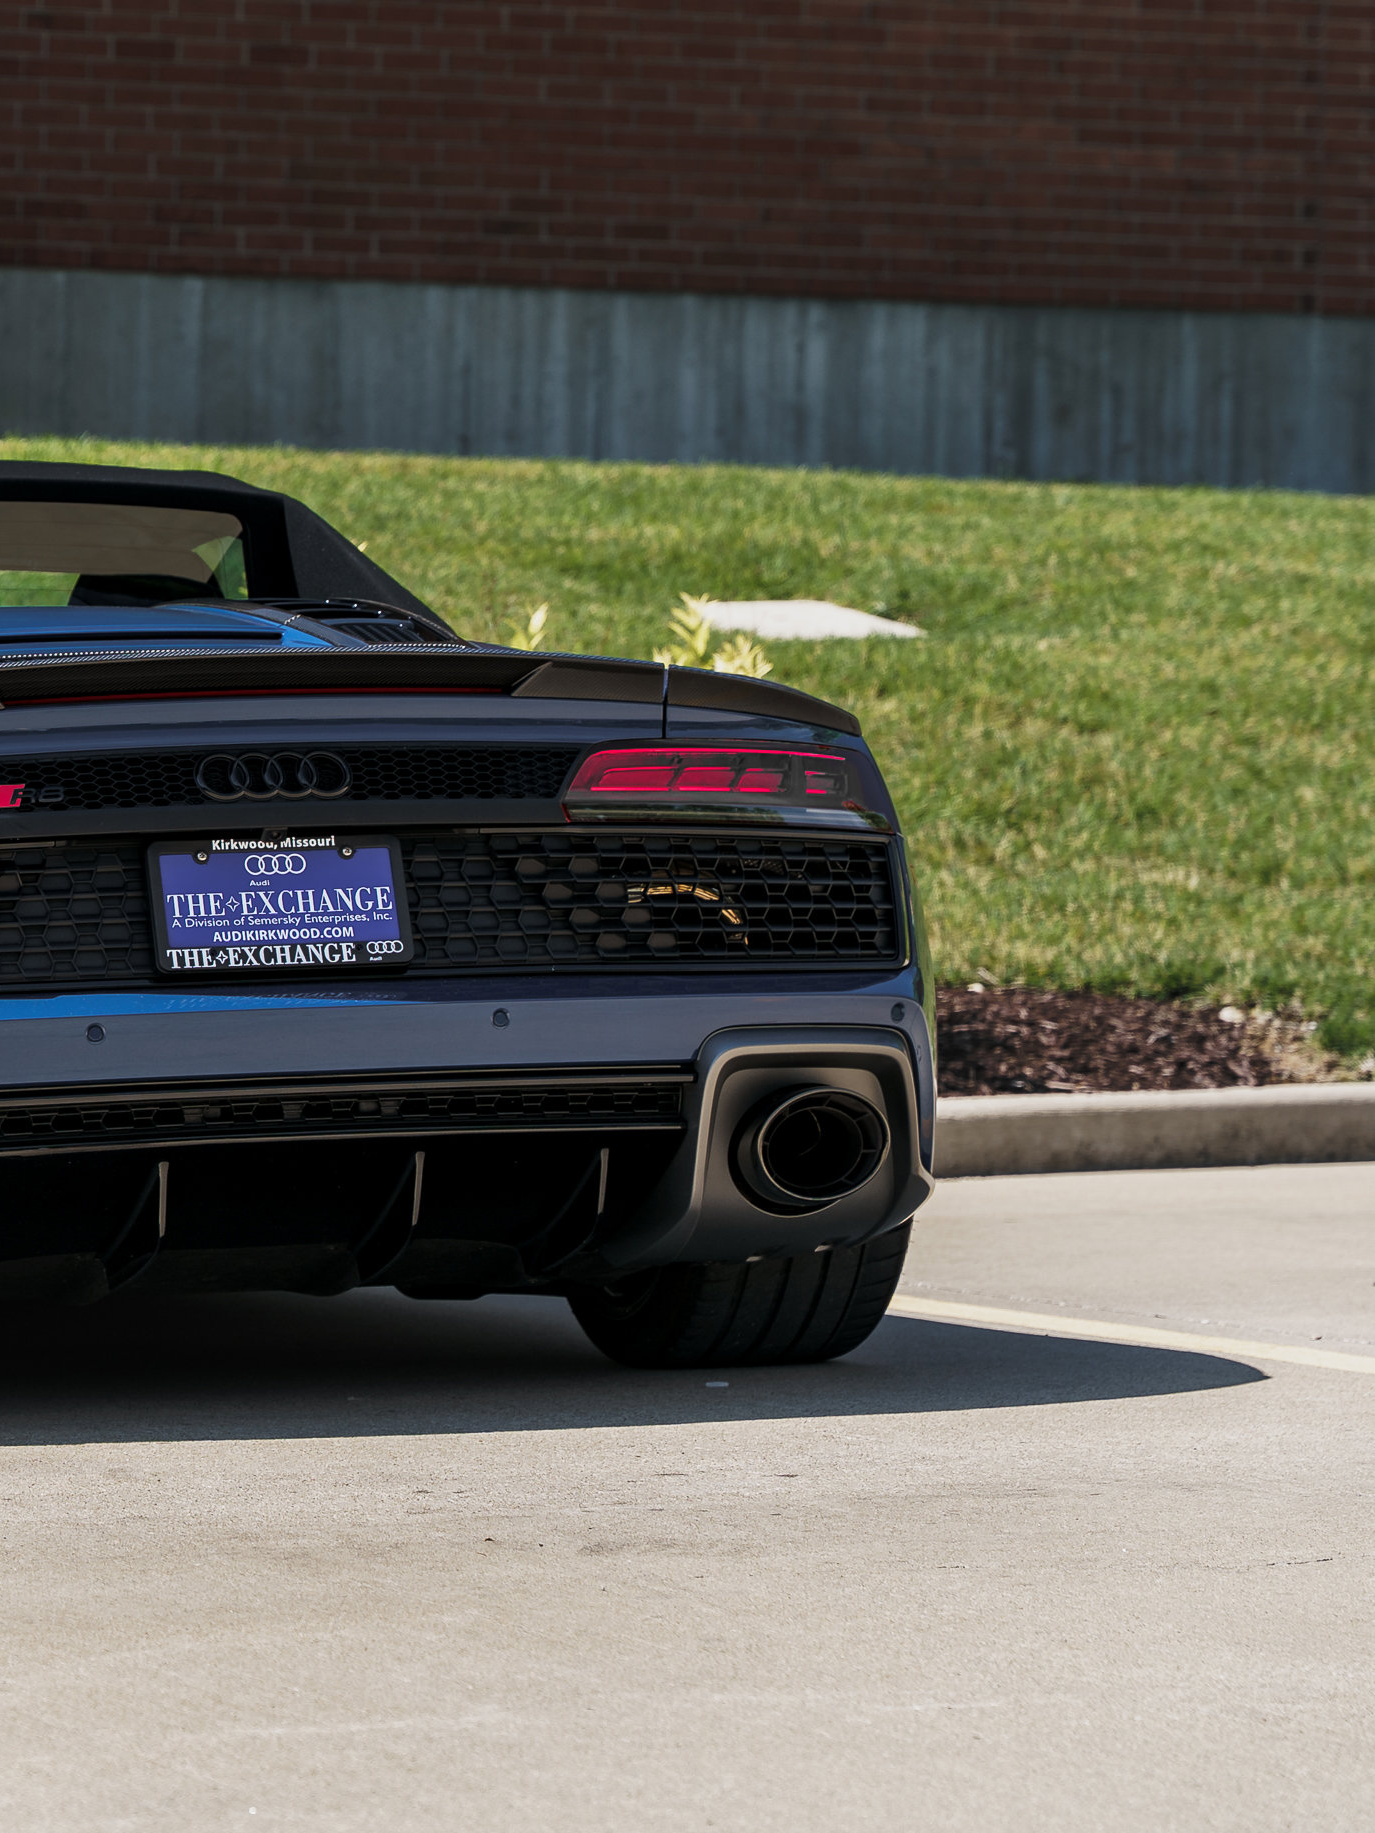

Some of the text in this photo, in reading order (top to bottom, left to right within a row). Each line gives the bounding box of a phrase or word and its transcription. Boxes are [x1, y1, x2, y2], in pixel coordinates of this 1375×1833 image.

[280, 835, 336, 848] Missouri
[167, 887, 393, 918] THE EXCHANGE
[172, 918, 181, 928] A
[185, 917, 232, 928] Division
[235, 916, 246, 926] of
[248, 914, 301, 927] Semersky
[373, 911, 393, 921] Inc.
[213, 927, 354, 942] AUDIKIRKWOOD.COM
[167, 942, 356, 969] THE EXCHANGE
